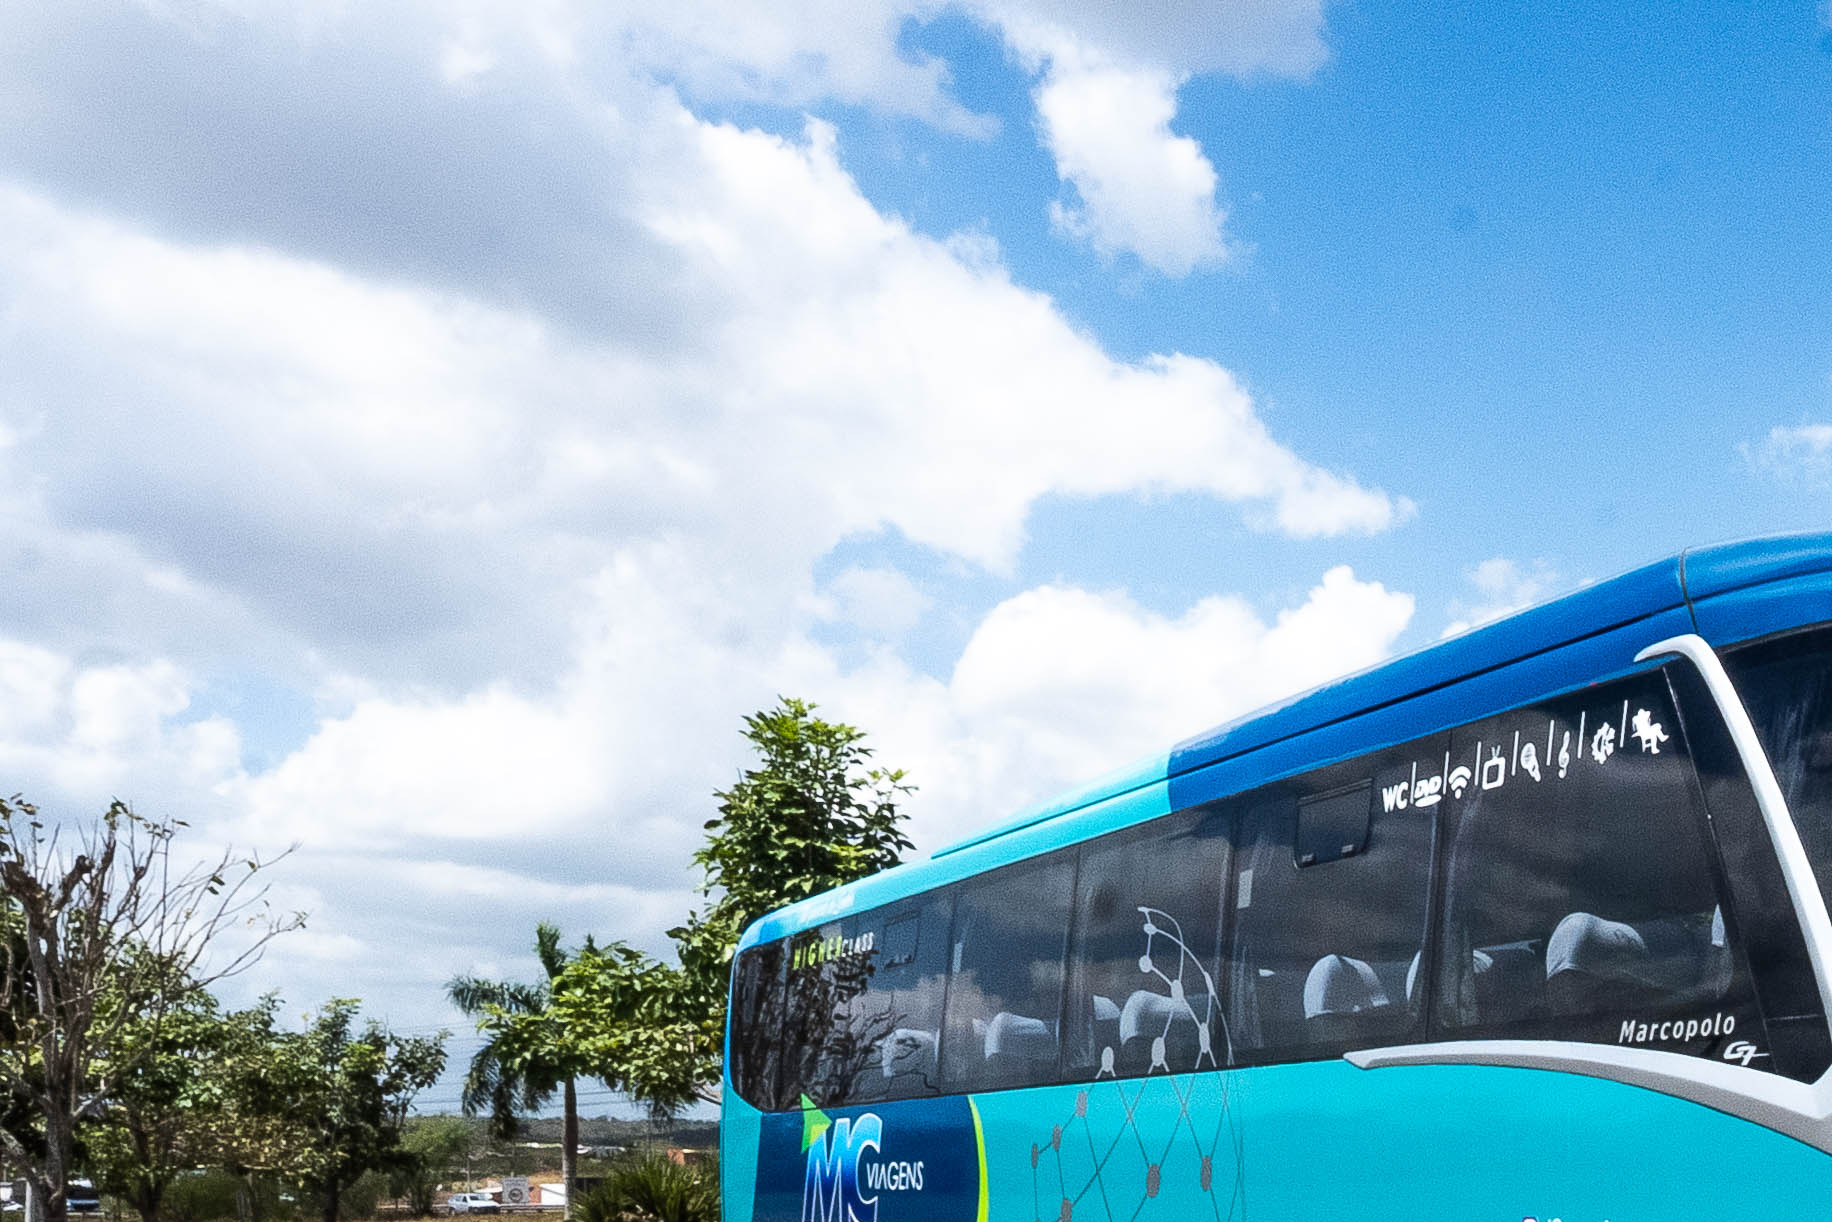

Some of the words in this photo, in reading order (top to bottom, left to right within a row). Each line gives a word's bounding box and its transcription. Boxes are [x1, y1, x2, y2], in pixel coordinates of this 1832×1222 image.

[1382, 781, 1409, 813] WC
[1618, 1012, 1735, 1043] Marcopolo
[866, 1161, 924, 1191] VIAGENS
